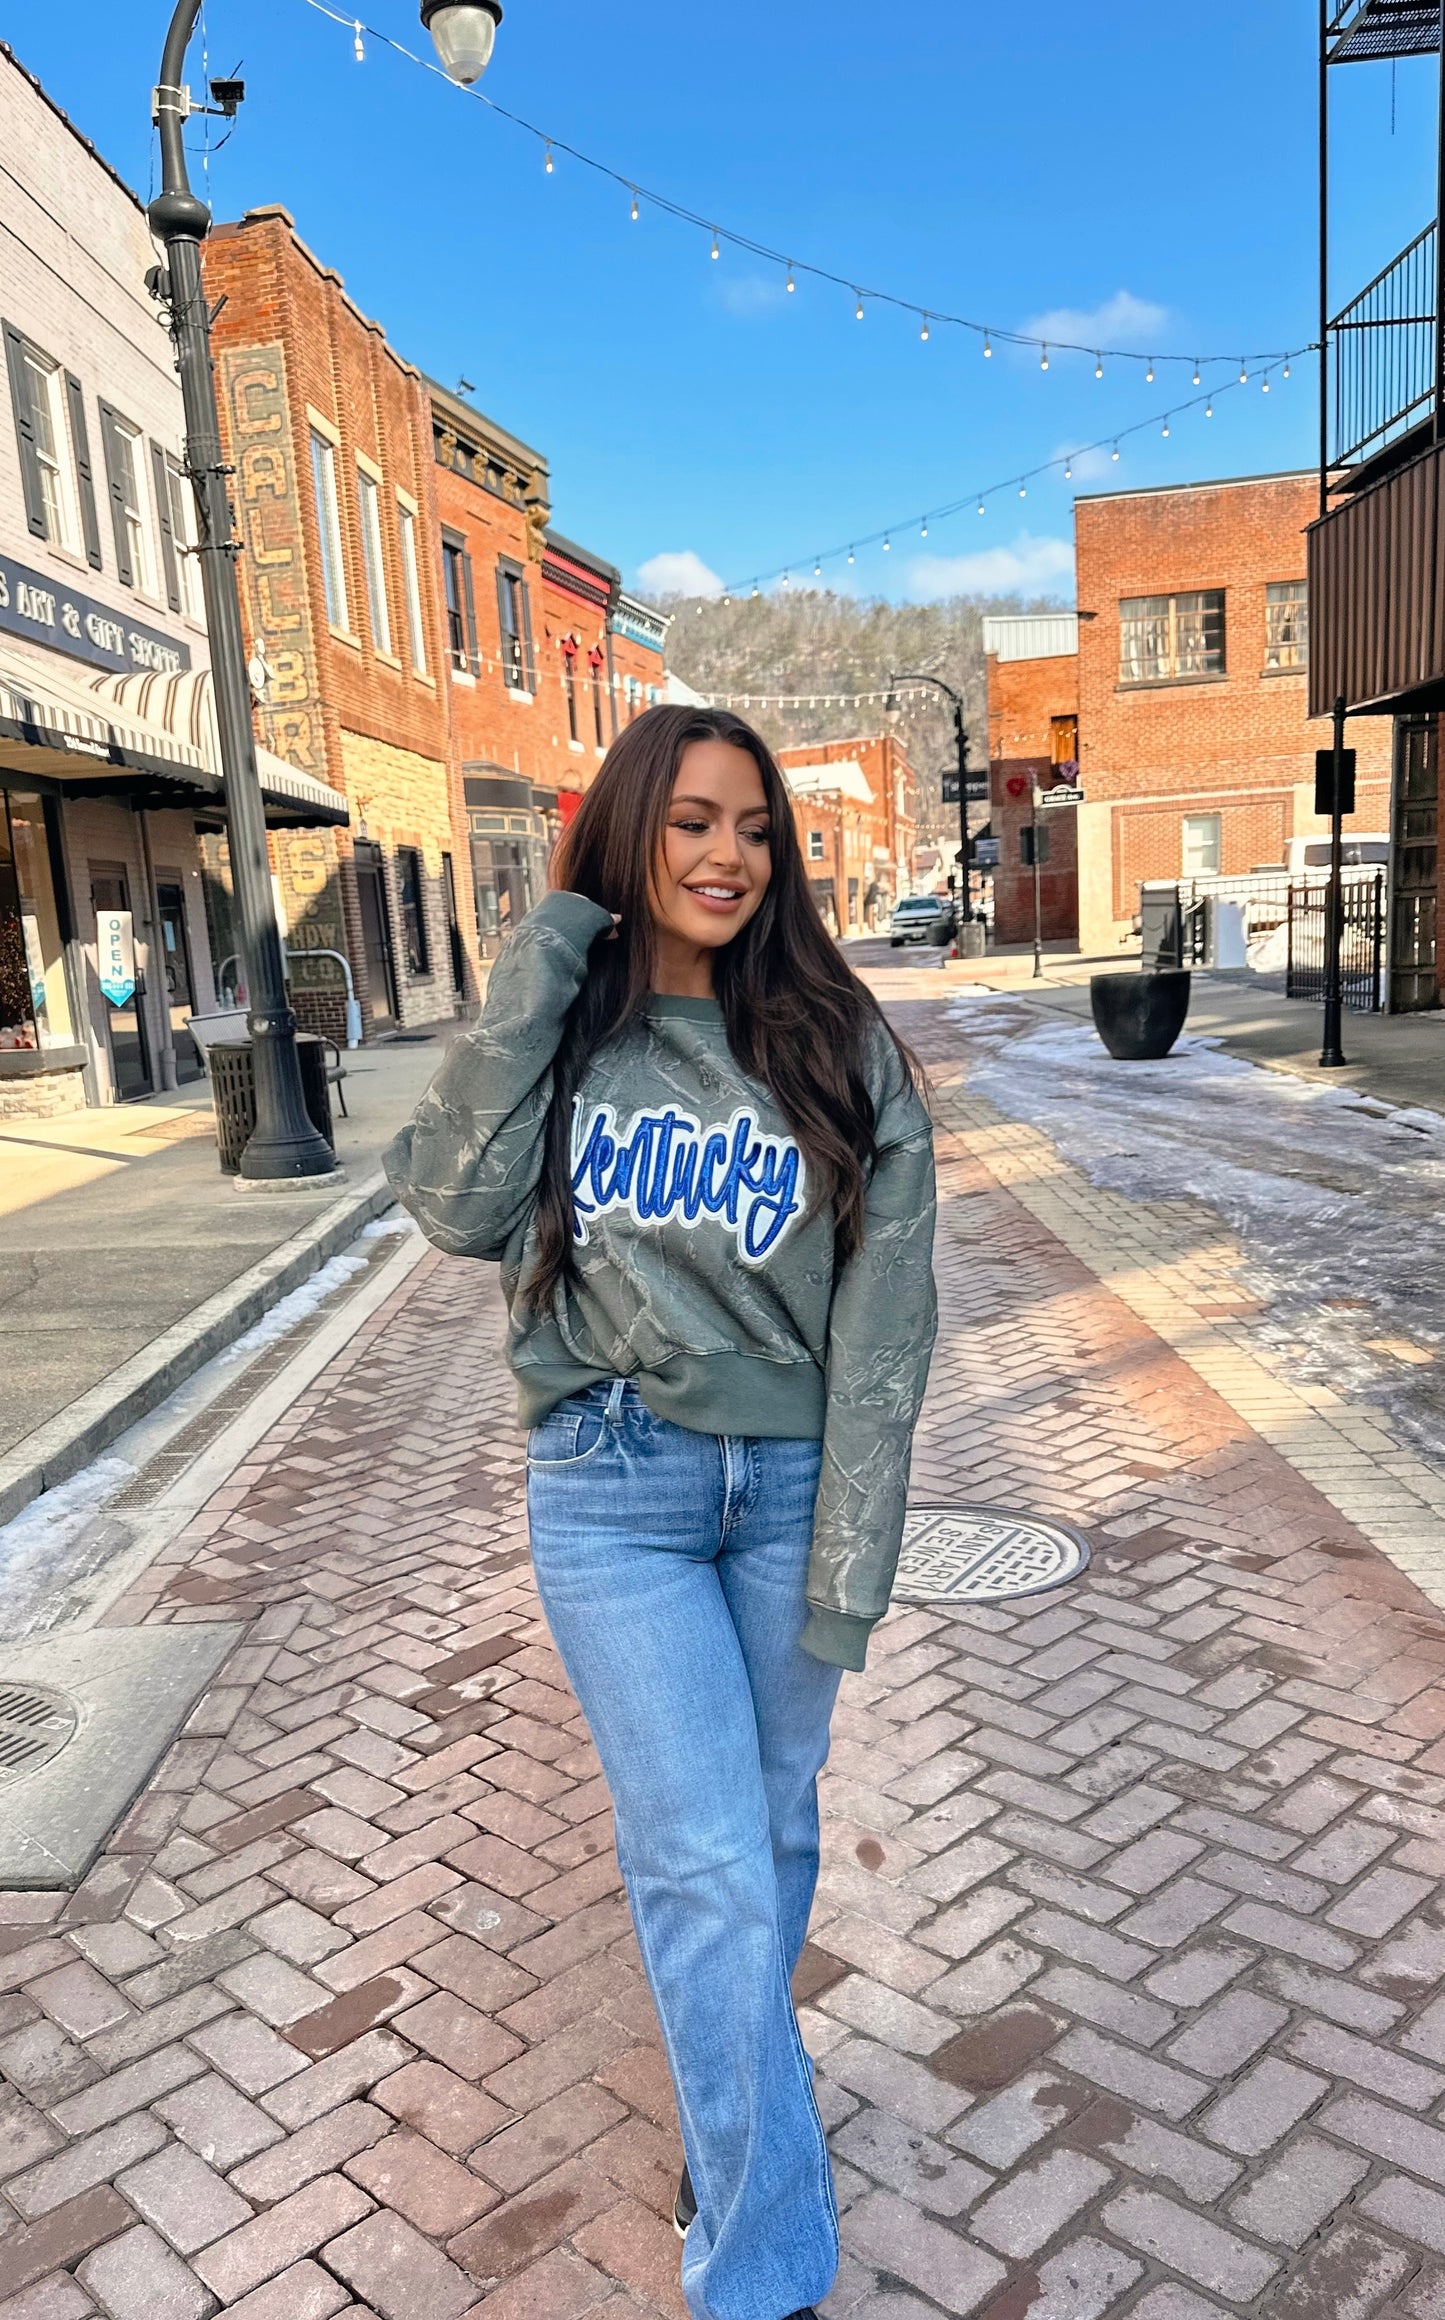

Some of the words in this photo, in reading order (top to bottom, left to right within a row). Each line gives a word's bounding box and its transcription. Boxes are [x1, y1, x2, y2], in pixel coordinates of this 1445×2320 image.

[233, 369, 302, 632] CALL
[16, 581, 56, 627] ART
[61, 602, 82, 639] &
[85, 613, 125, 656] GIFT
[109, 919, 123, 977] OPEN
[292, 922, 337, 949] HDW
[913, 1524, 1004, 1591] SANITARY
